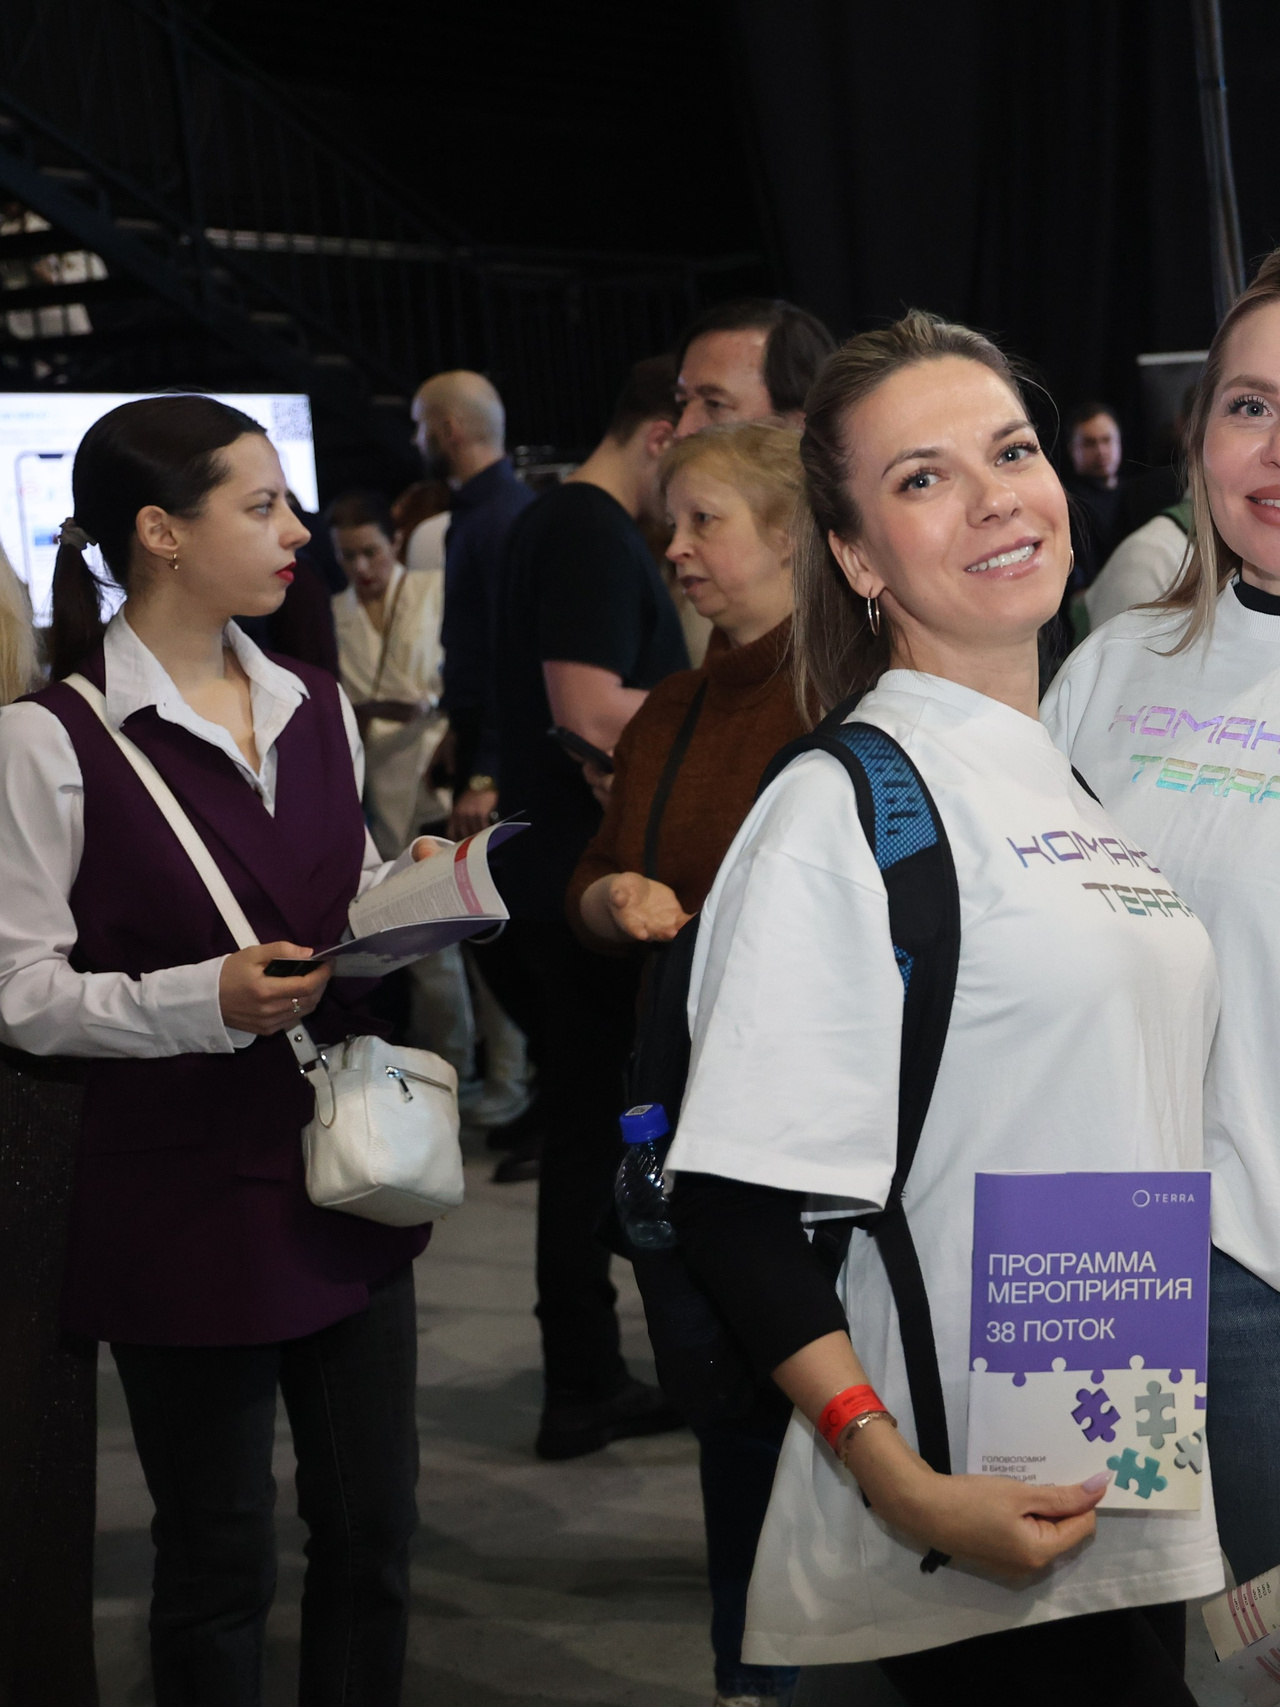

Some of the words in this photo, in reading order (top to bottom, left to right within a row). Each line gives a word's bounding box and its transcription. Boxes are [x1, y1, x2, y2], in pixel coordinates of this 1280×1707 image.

[1154, 1193, 1195, 1203] TERRA
[988, 1251, 1156, 1277] ПРОГРАММА
[988, 1278, 1192, 1304] МЕРОПРИЯТИЯ
[986, 1322, 1015, 1342] 38
[1023, 1317, 1115, 1342] ПОТОК
[981, 1455, 1046, 1463] ГОЛОВОЛОМКИ
